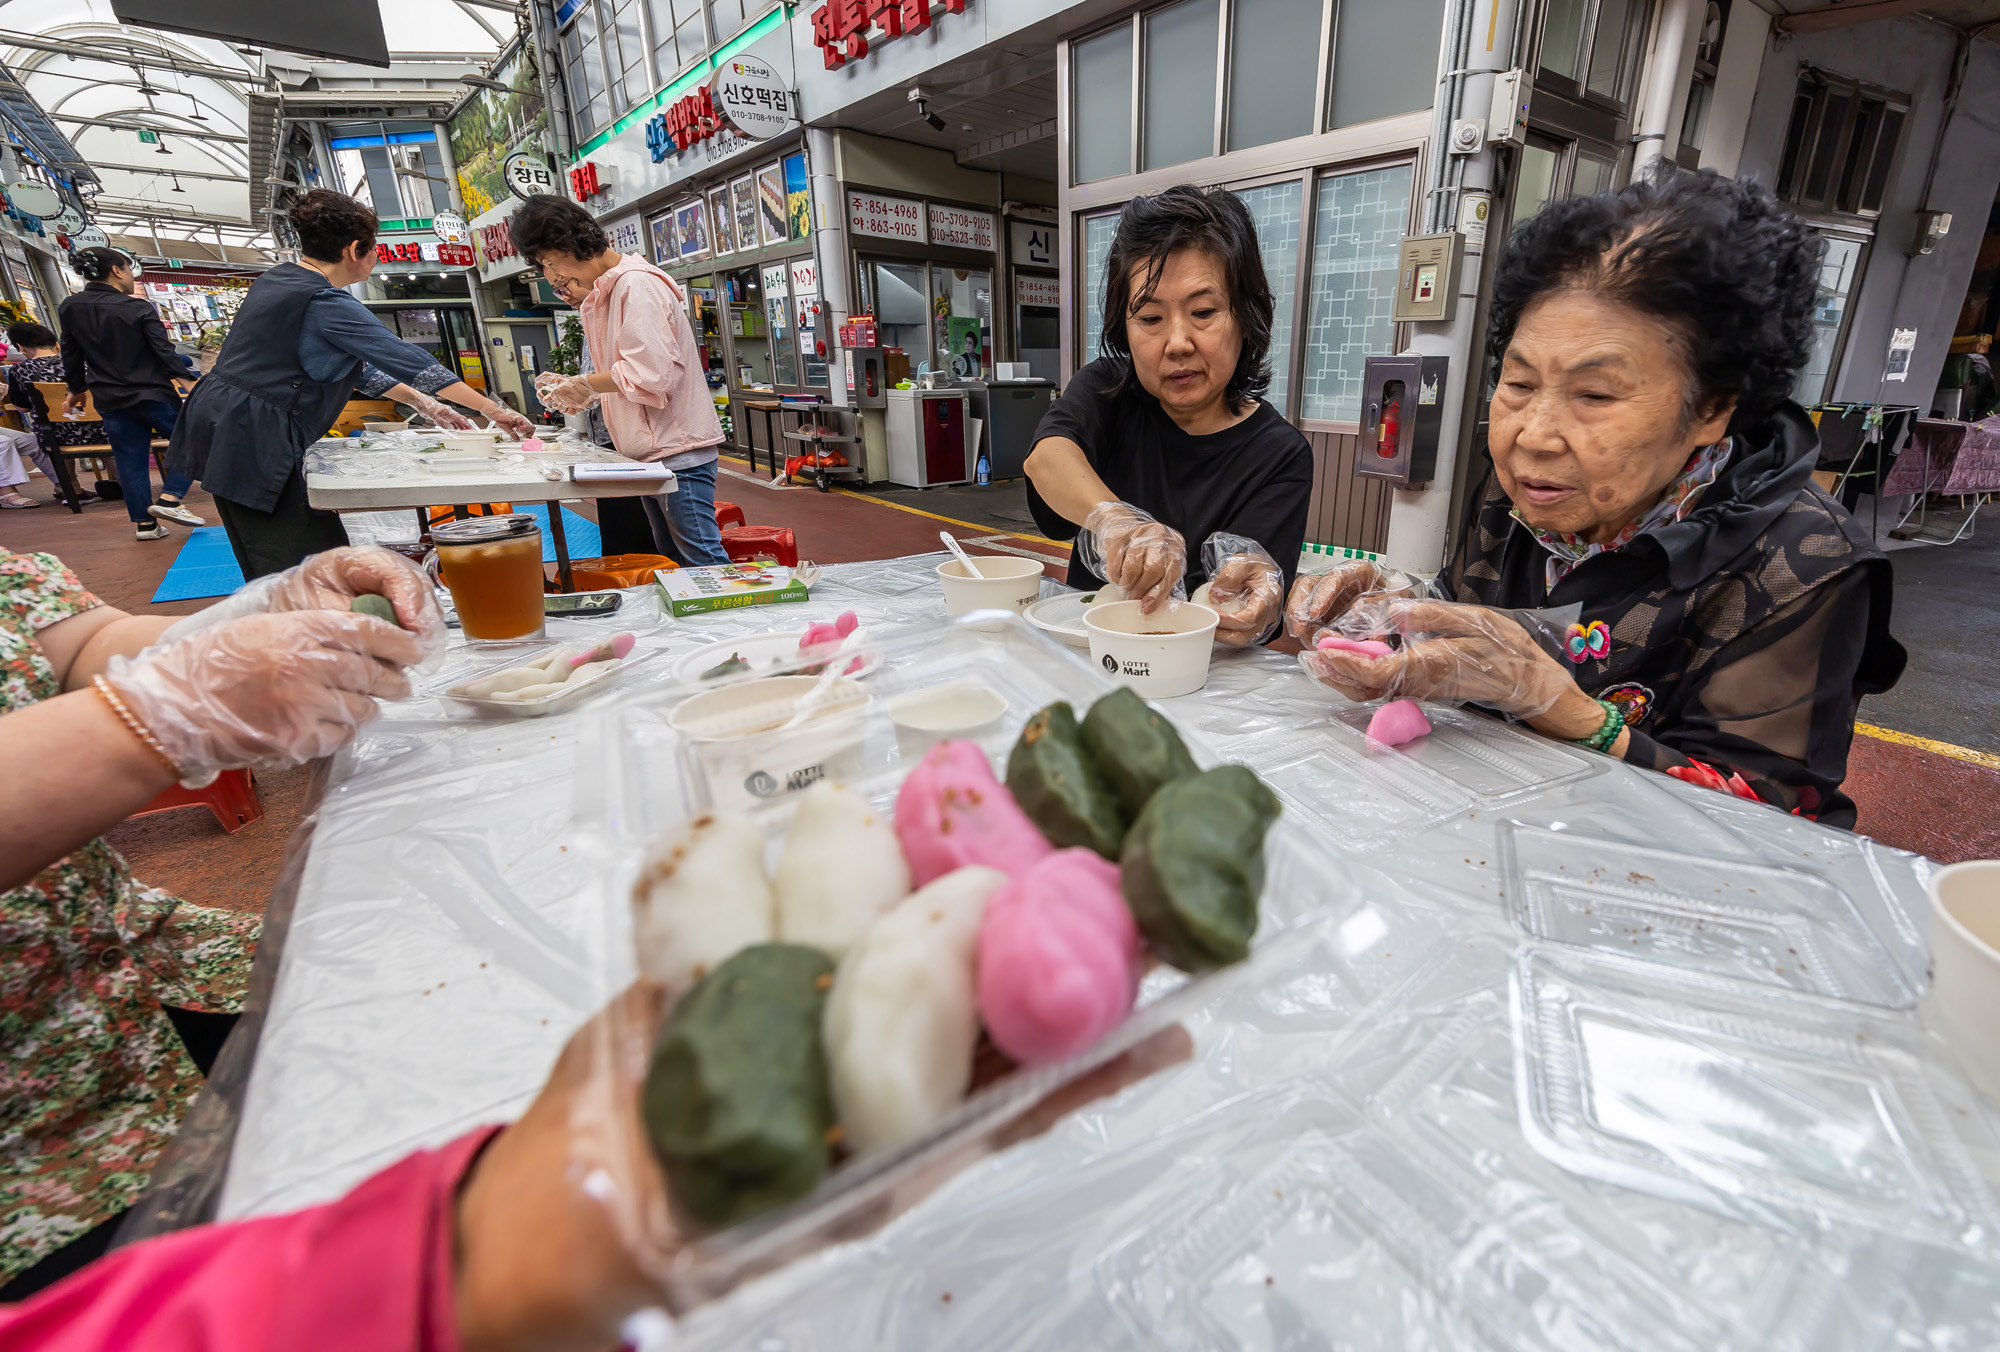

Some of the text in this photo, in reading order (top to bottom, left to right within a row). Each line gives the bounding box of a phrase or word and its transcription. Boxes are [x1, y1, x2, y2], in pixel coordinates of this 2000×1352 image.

[723, 83, 788, 111] 신호떡집
[731, 109, 785, 124] 010-3708-9105
[514, 167, 551, 186] 장터
[570, 162, 599, 203] 장터
[930, 209, 991, 231] 010-3708-9105
[930, 226, 992, 248] 010-5323-9105
[1028, 230, 1050, 263] 신
[1122, 660, 1150, 668] LOTTE
[1123, 667, 1150, 677] Mart
